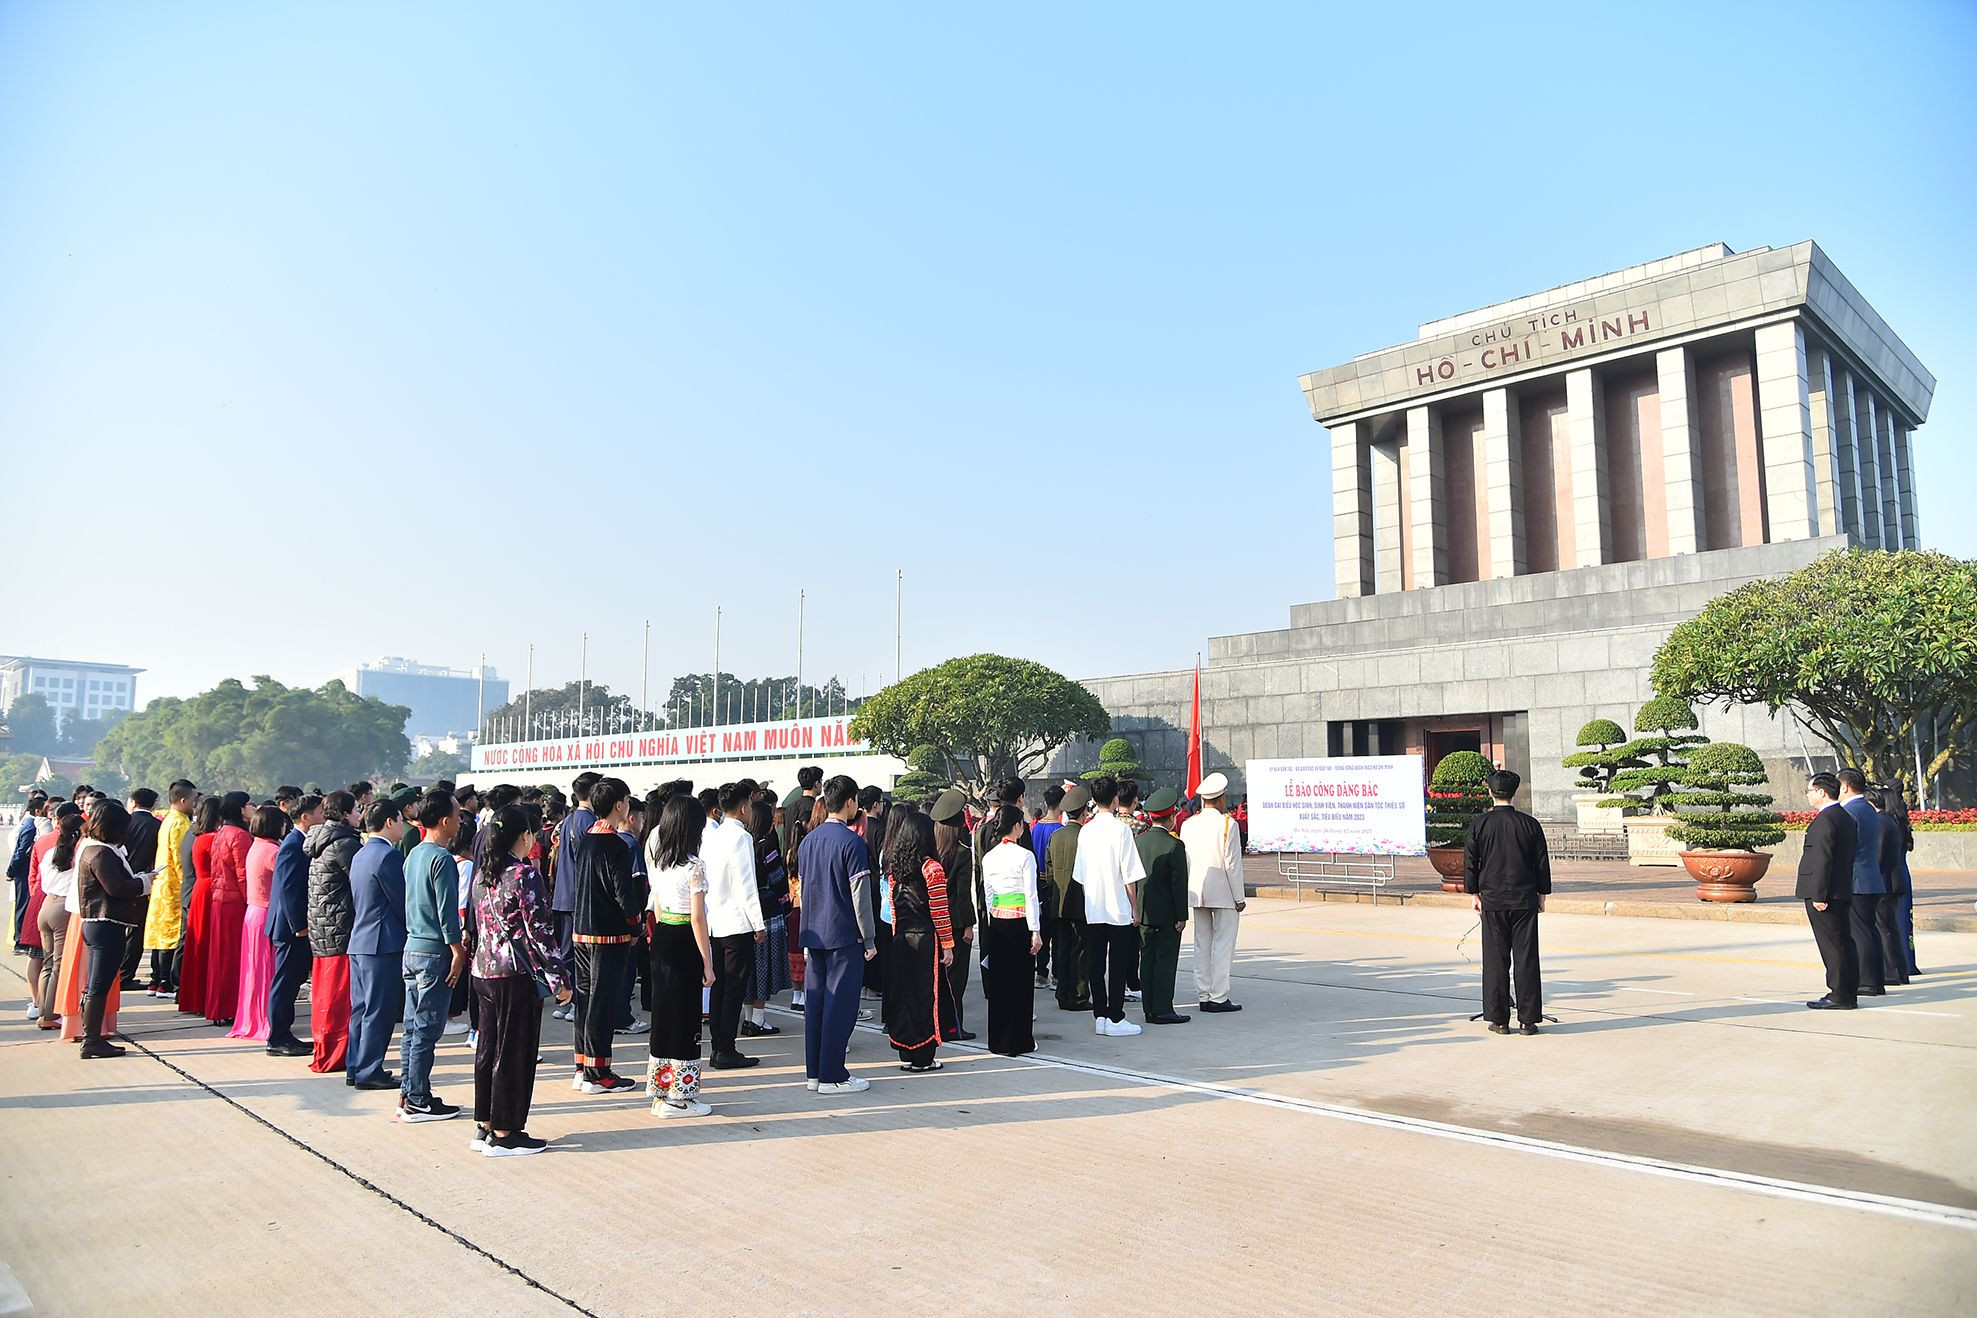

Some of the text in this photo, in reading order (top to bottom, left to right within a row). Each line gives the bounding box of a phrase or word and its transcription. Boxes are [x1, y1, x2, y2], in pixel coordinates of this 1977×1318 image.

[1471, 322, 1512, 346] CHỦ
[1416, 355, 1456, 386] HỒ
[1480, 333, 1531, 369] CHÍ
[512, 745, 538, 766] CỘNG
[567, 741, 581, 761] XÃ
[585, 738, 605, 763] HỘI
[609, 734, 633, 759] CHỦ
[639, 733, 679, 758] NGHĨA
[686, 730, 716, 757] VIỆT
[723, 730, 757, 753] NAM
[764, 723, 813, 750] MUÔN
